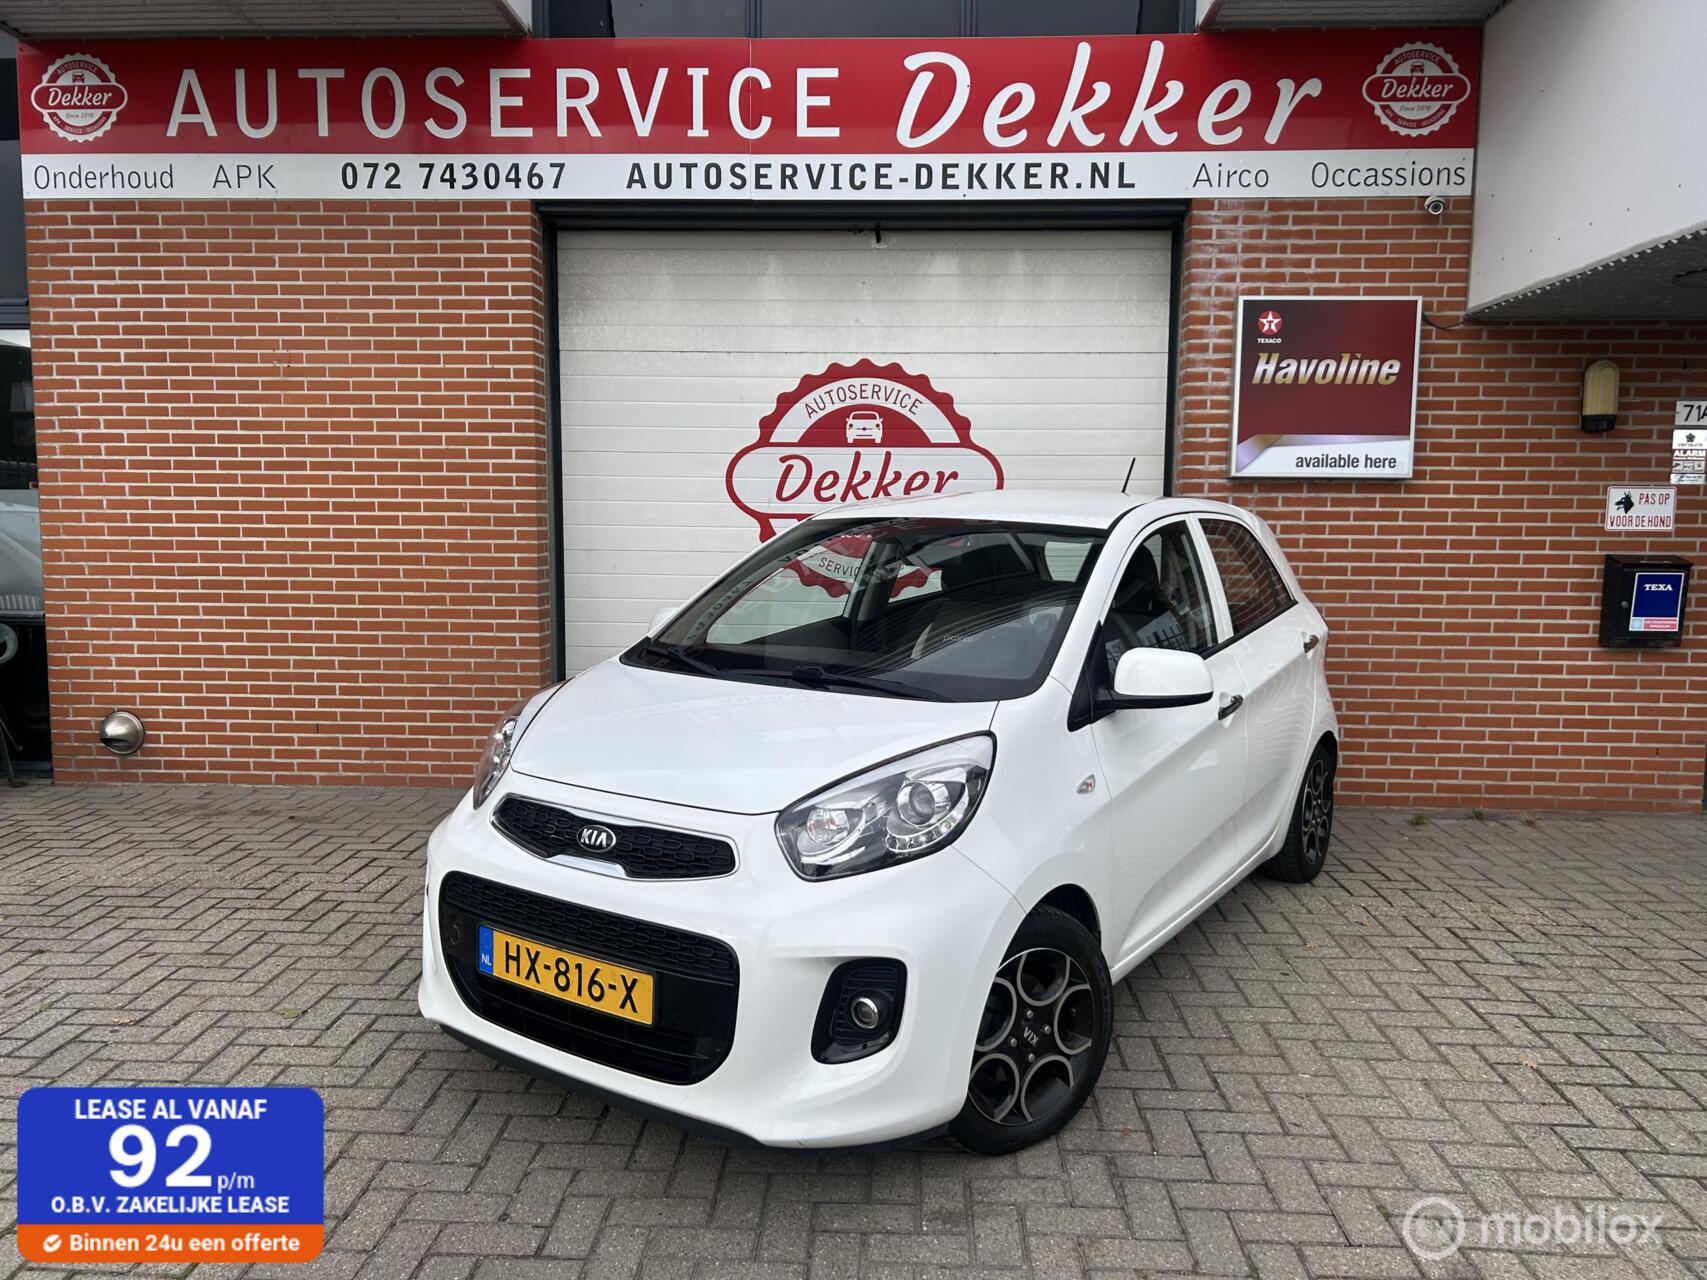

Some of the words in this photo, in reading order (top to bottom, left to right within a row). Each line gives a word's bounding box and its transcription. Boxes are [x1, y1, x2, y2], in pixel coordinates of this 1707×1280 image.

[48, 86, 112, 106] Dekker
[166, 66, 840, 139] AUTOSERVICE
[896, 40, 1322, 148] Dekker
[1381, 76, 1454, 98] Dekker
[34, 164, 174, 191] Onderhoud
[212, 164, 276, 190] APK
[341, 162, 402, 190] 072
[419, 162, 566, 190] 7430467
[626, 161, 1136, 190] AUTOSERVICE-DEKKER.NL
[1193, 162, 1270, 189] Airco
[1311, 159, 1466, 190] Occassions
[1252, 352, 1401, 386] Havoline
[804, 383, 924, 419] AUTOSERVICE
[1295, 453, 1360, 469] available
[1364, 454, 1397, 469] here
[775, 450, 959, 502] Dekker
[1638, 493, 1656, 505] PAS
[1658, 493, 1671, 505] OP
[1609, 515, 1633, 528] VOOR
[1635, 515, 1646, 528] DE
[1648, 515, 1672, 528] HOND
[818, 556, 861, 578] SERVIC
[1643, 583, 1673, 591] TEXA
[580, 828, 609, 848] KIA
[481, 952, 492, 967] NL
[504, 940, 639, 1014] HX-816-X
[1022, 1026, 1040, 1047] KIA
